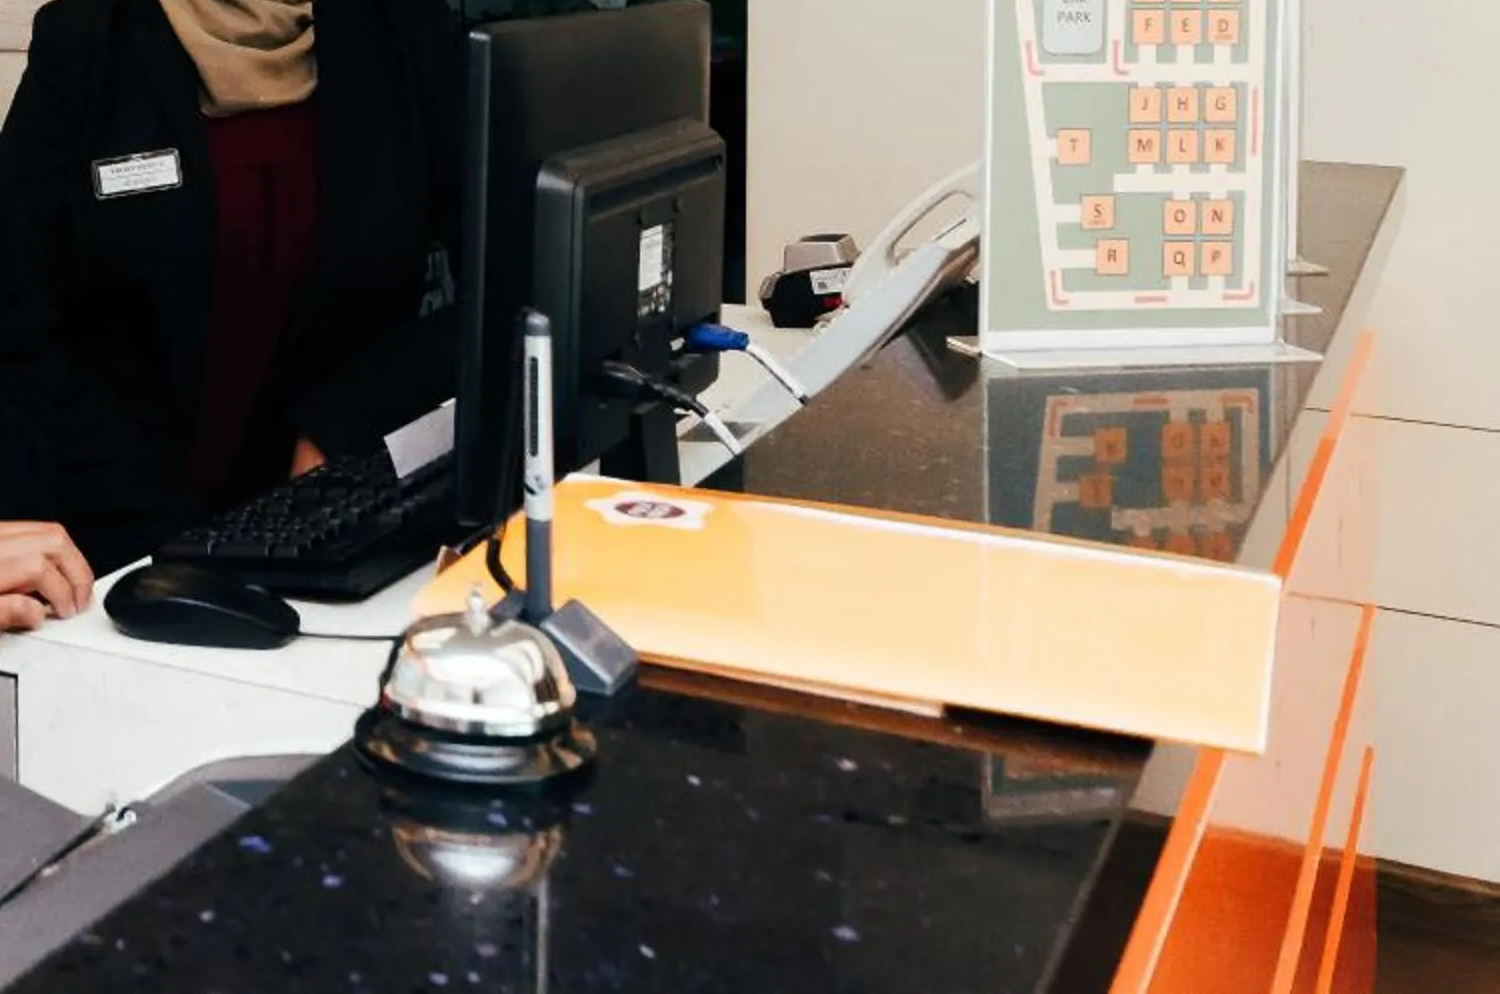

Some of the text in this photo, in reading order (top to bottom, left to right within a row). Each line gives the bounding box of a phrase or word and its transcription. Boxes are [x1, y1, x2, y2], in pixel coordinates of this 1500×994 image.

[1057, 11, 1091, 23] PARK
[1144, 17, 1229, 33] F E D
[1141, 96, 1227, 111] J H G
[1069, 138, 1079, 153] T
[1137, 137, 1225, 153] M L K
[1093, 204, 1102, 219] S
[1211, 209, 1223, 223] N
[1173, 250, 1221, 268] Q P
